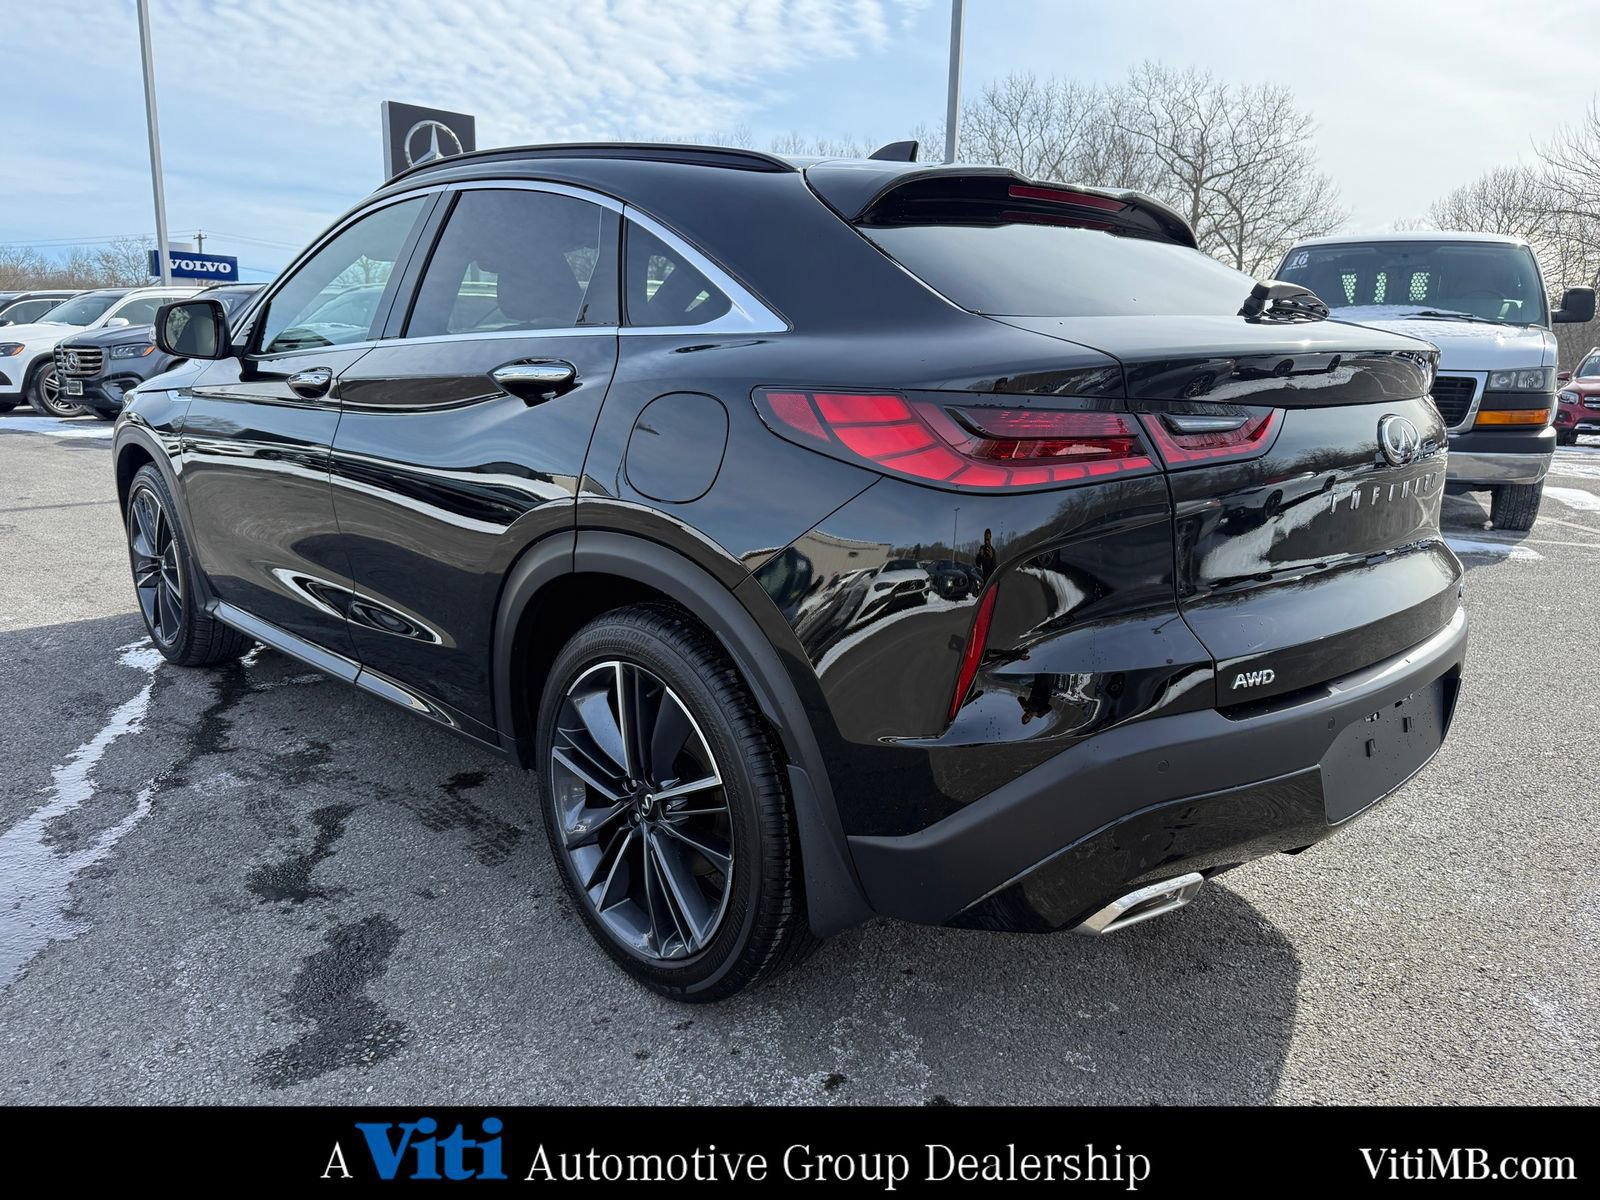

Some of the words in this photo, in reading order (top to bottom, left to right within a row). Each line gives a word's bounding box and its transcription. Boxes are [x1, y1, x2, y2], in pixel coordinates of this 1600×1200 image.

[169, 259, 232, 273] VOLVO
[1330, 472, 1437, 513] INFINITI
[583, 628, 651, 643] BRIDGESTONE
[1232, 669, 1275, 690] AWD
